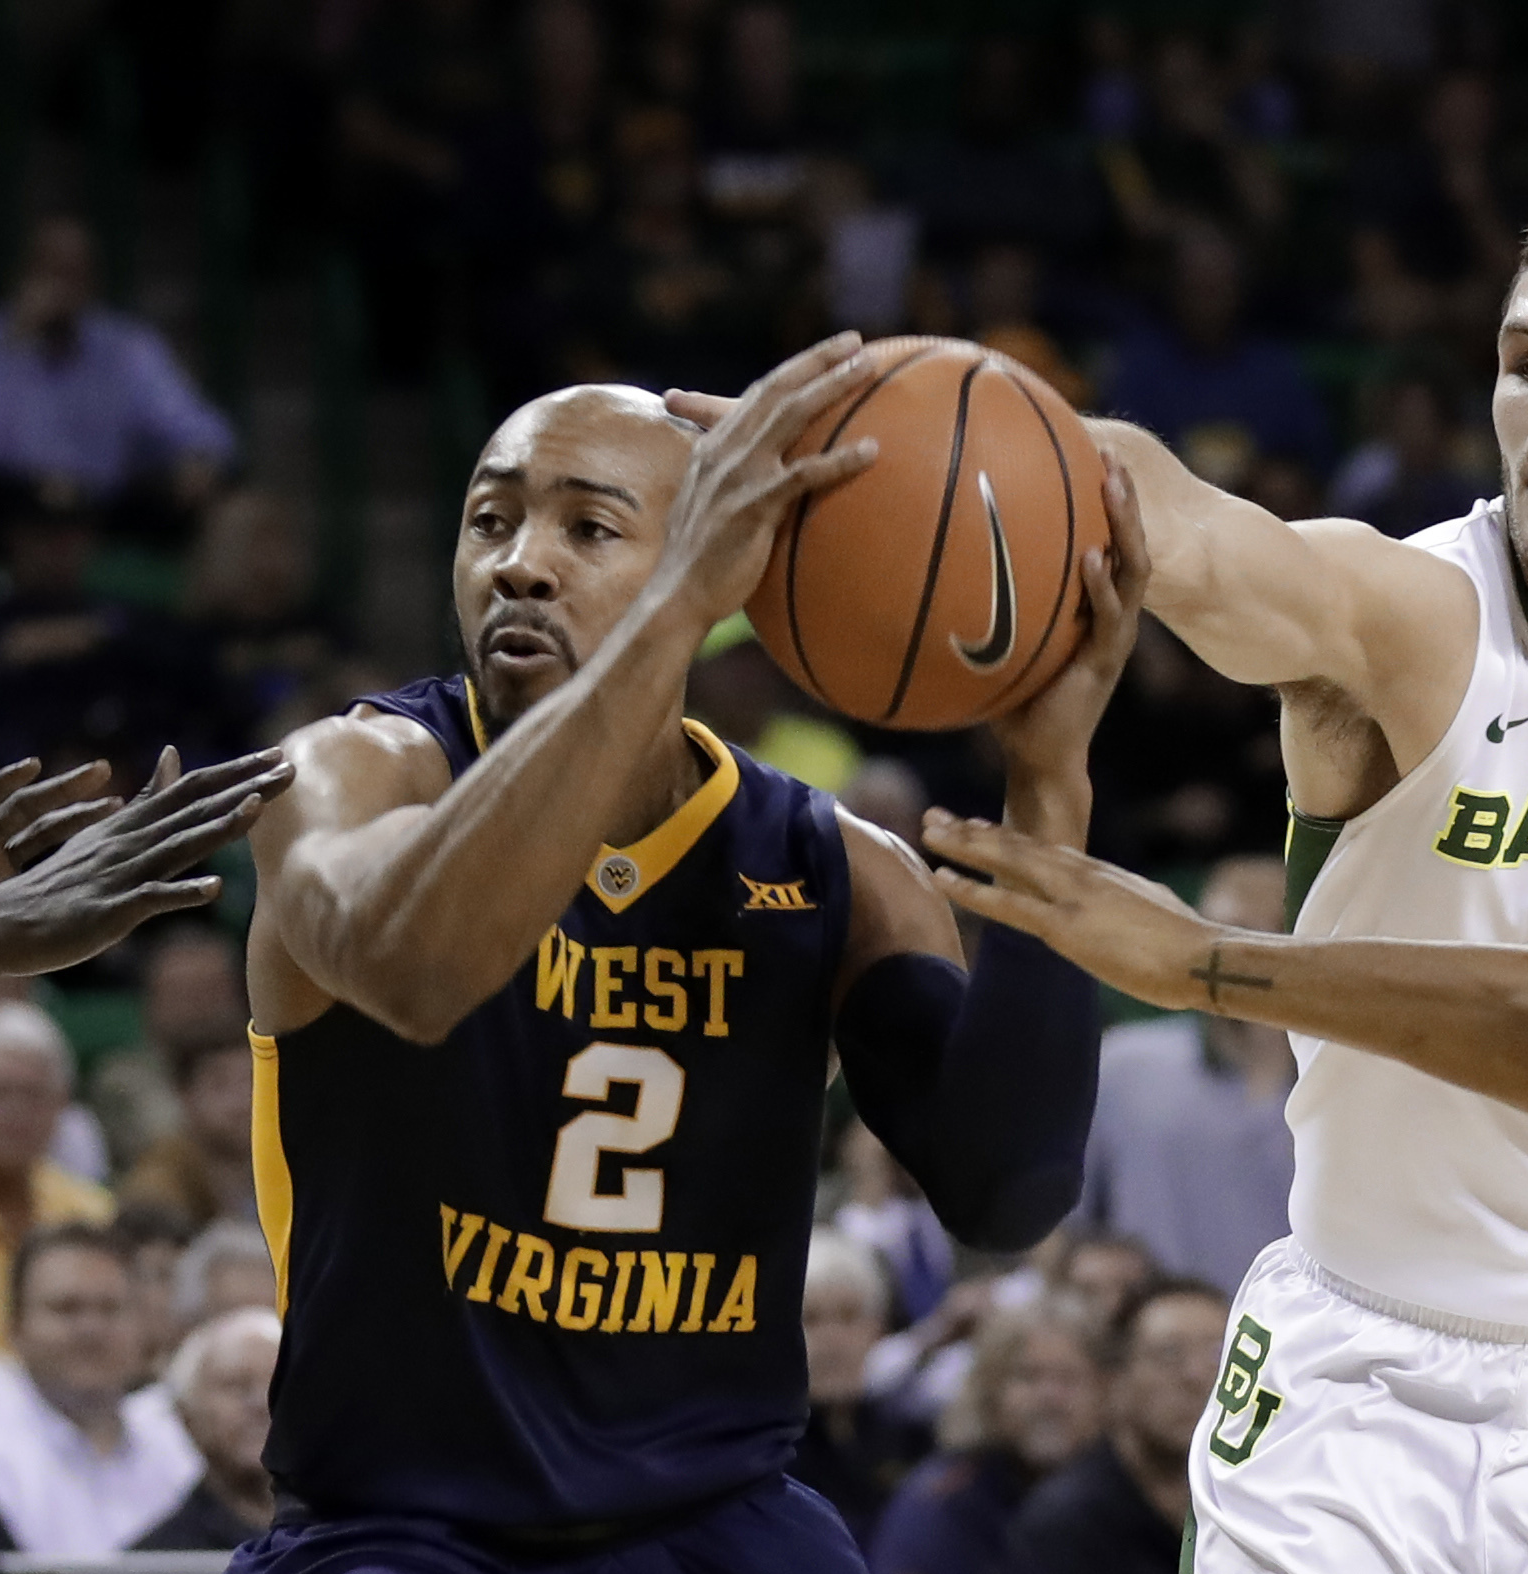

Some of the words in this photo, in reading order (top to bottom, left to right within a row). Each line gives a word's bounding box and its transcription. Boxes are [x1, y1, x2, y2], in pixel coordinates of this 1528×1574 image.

[534, 923, 744, 1038] WEST
[542, 1041, 686, 1234] 2
[439, 1202, 758, 1335] VIRGINIA
